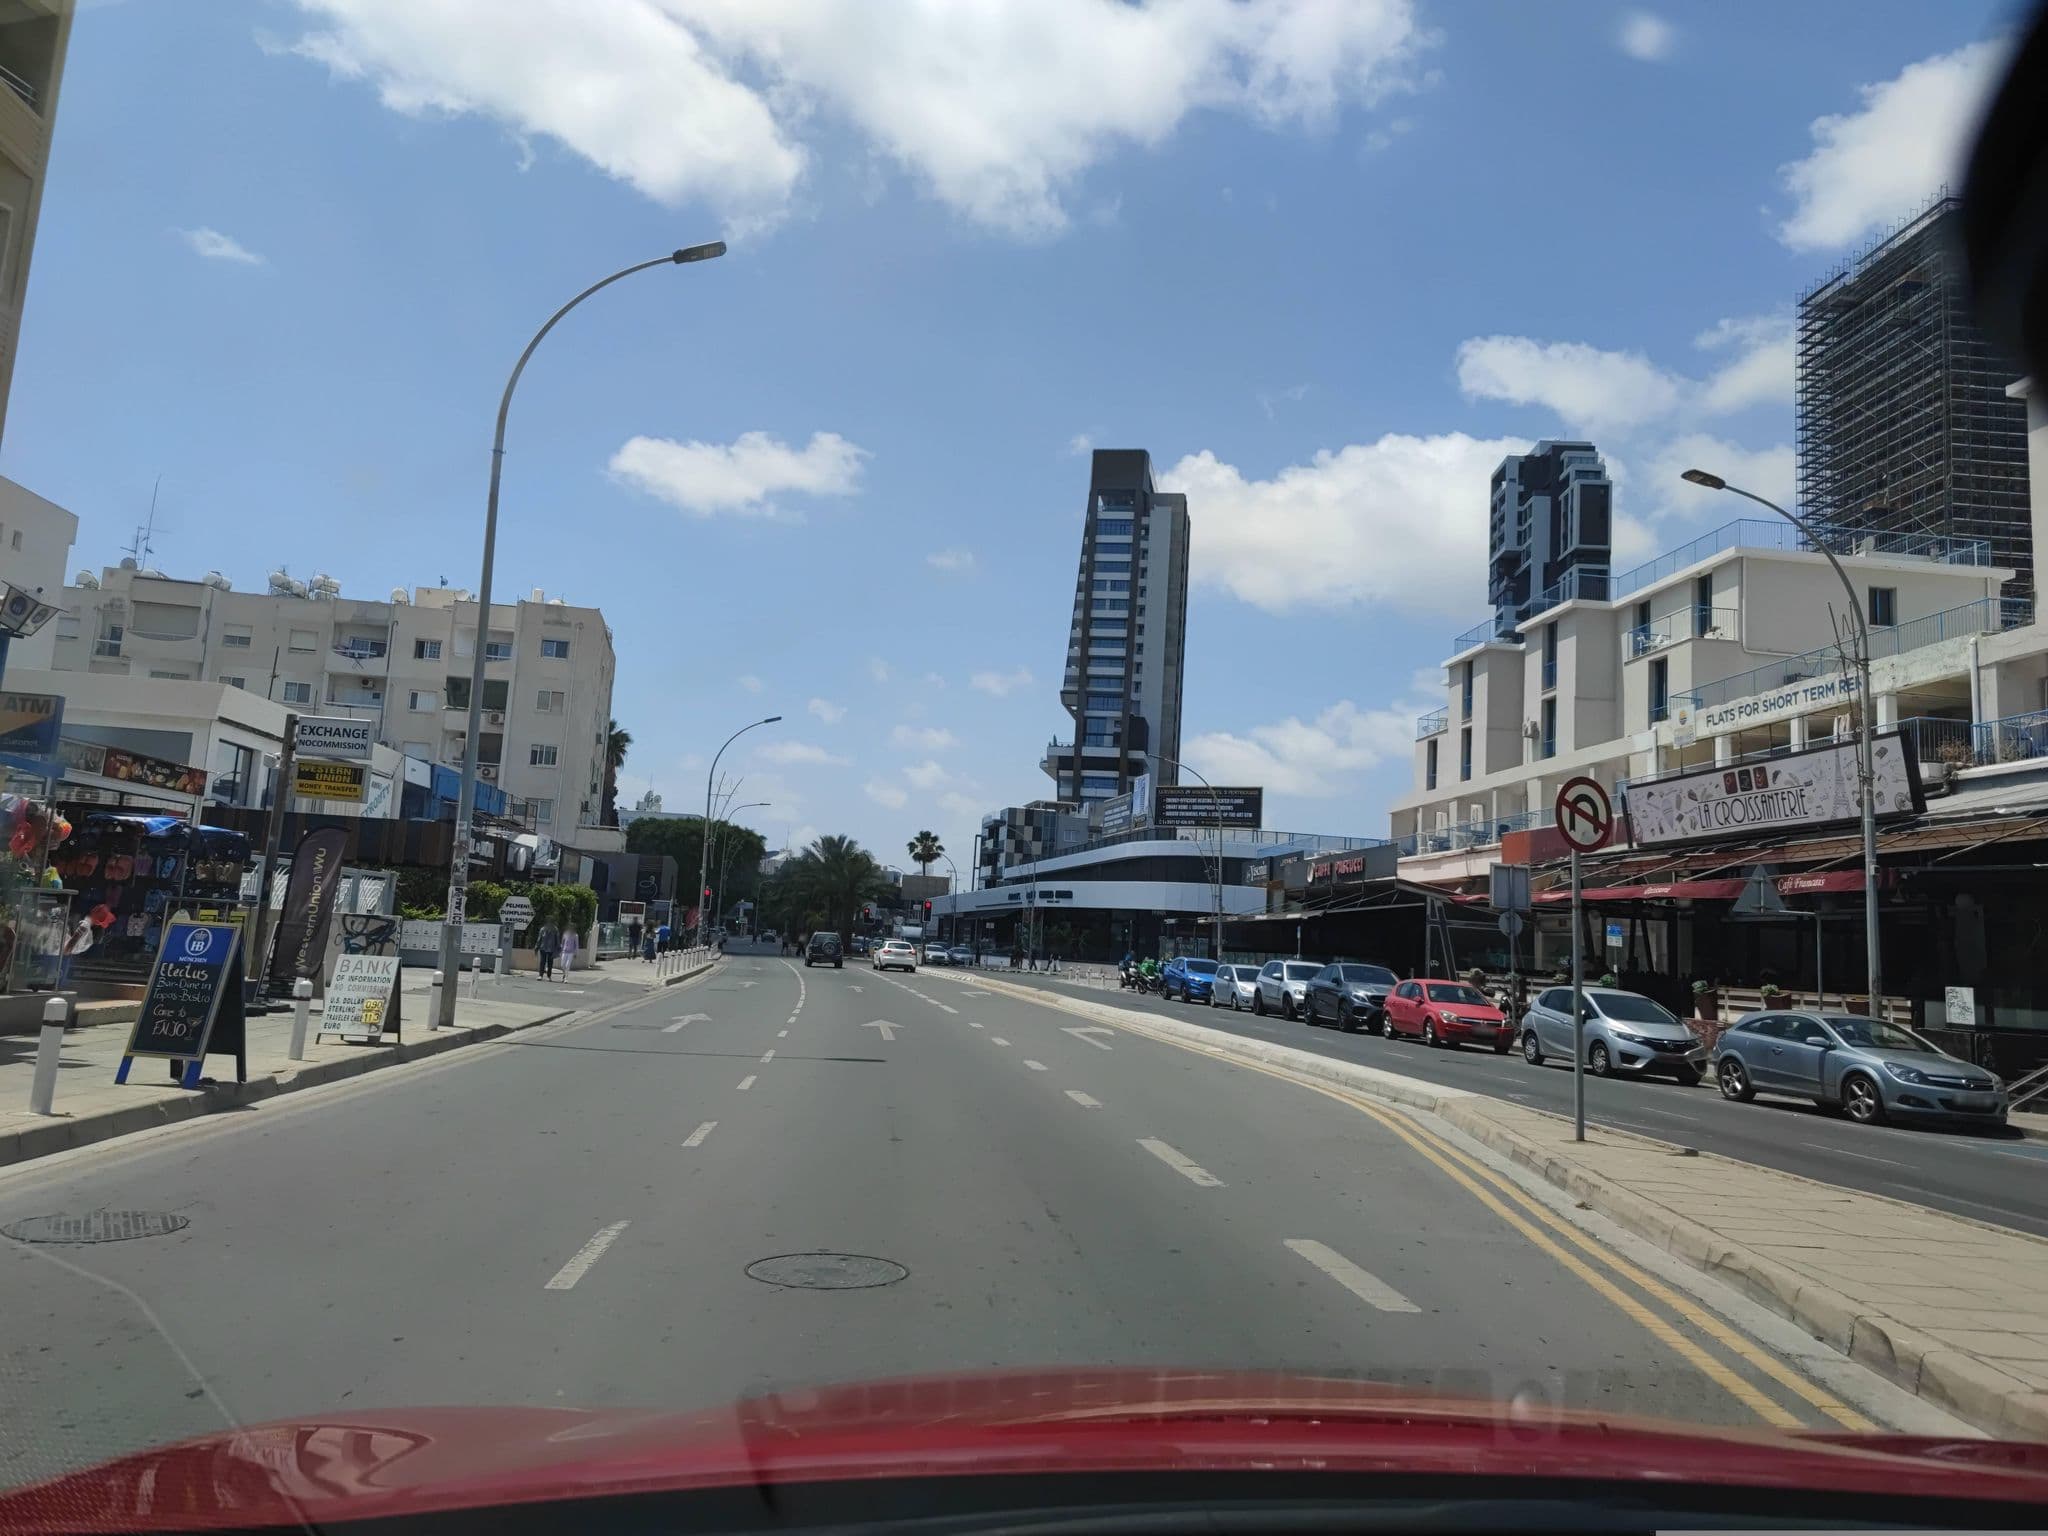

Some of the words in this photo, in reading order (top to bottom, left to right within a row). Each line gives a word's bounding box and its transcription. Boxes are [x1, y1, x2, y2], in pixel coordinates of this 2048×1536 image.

[1706, 708, 1736, 728] FLATS
[1738, 704, 1760, 719] FOR
[1762, 692, 1800, 712] SHORT
[1802, 682, 1836, 702] TERM
[301, 724, 368, 740] EXCHANGE
[1700, 803, 1712, 829] LA
[1714, 788, 1808, 826] CROISSANTERIE
[340, 959, 392, 975] BANK
[348, 976, 392, 984] INFORMATION
